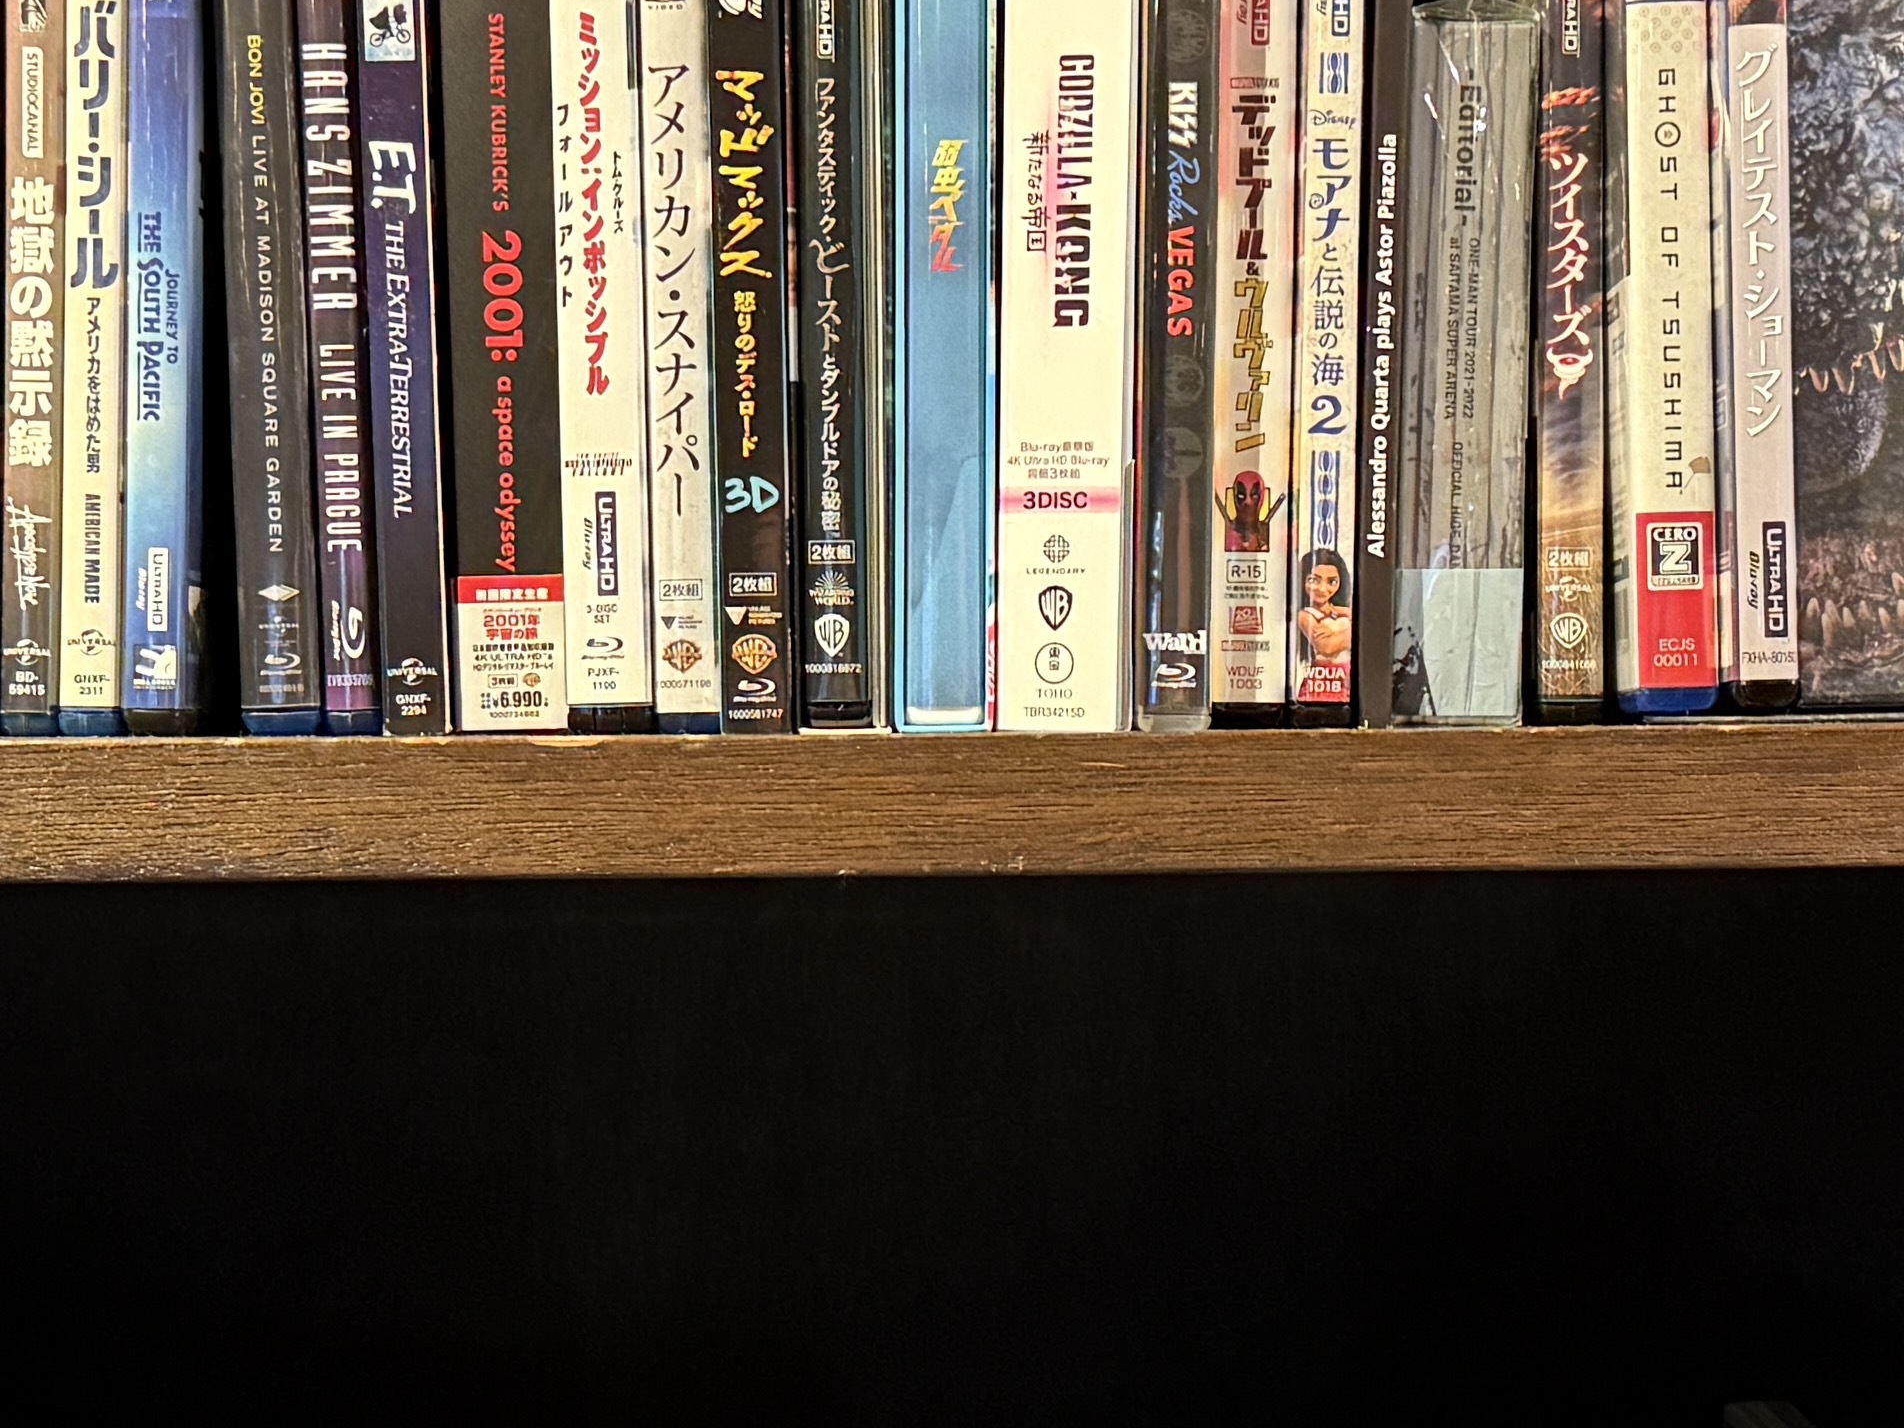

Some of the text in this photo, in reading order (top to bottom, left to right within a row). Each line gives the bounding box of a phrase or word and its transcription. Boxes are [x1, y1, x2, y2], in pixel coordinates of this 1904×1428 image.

[246, 34, 263, 66] BON
[248, 71, 266, 127] JOVI
[487, 13, 512, 211] STANLEY KUBRICK'S
[1168, 81, 1200, 147] KISS
[252, 134, 269, 187] LIVE
[256, 235, 276, 343] MADISON
[383, 219, 406, 270] THE
[1166, 225, 1196, 338] VEGAS
[1546, 152, 1594, 347] ツイスターズ
[1653, 68, 1685, 492] GHOST OF TSUSHIMA
[1734, 44, 1785, 439] グレイテスト・ショーマン
[7, 176, 56, 468] 地獄の黙示録
[301, 43, 365, 554] HANS ZIMMER LIVE IN PRAGUE
[647, 63, 702, 518] アメリカン・スナイパー
[1366, 134, 1399, 562] Alessandro Quarta plays Astor Piazolla
[261, 352, 280, 450] SQUARE
[265, 458, 284, 555] GARDEN
[724, 475, 780, 513] 3D
[1022, 489, 1090, 511] 3DISC
[1651, 525, 1697, 541] CERO
[1653, 652, 1699, 667] 00011
[1659, 638, 1696, 652] ECJS
